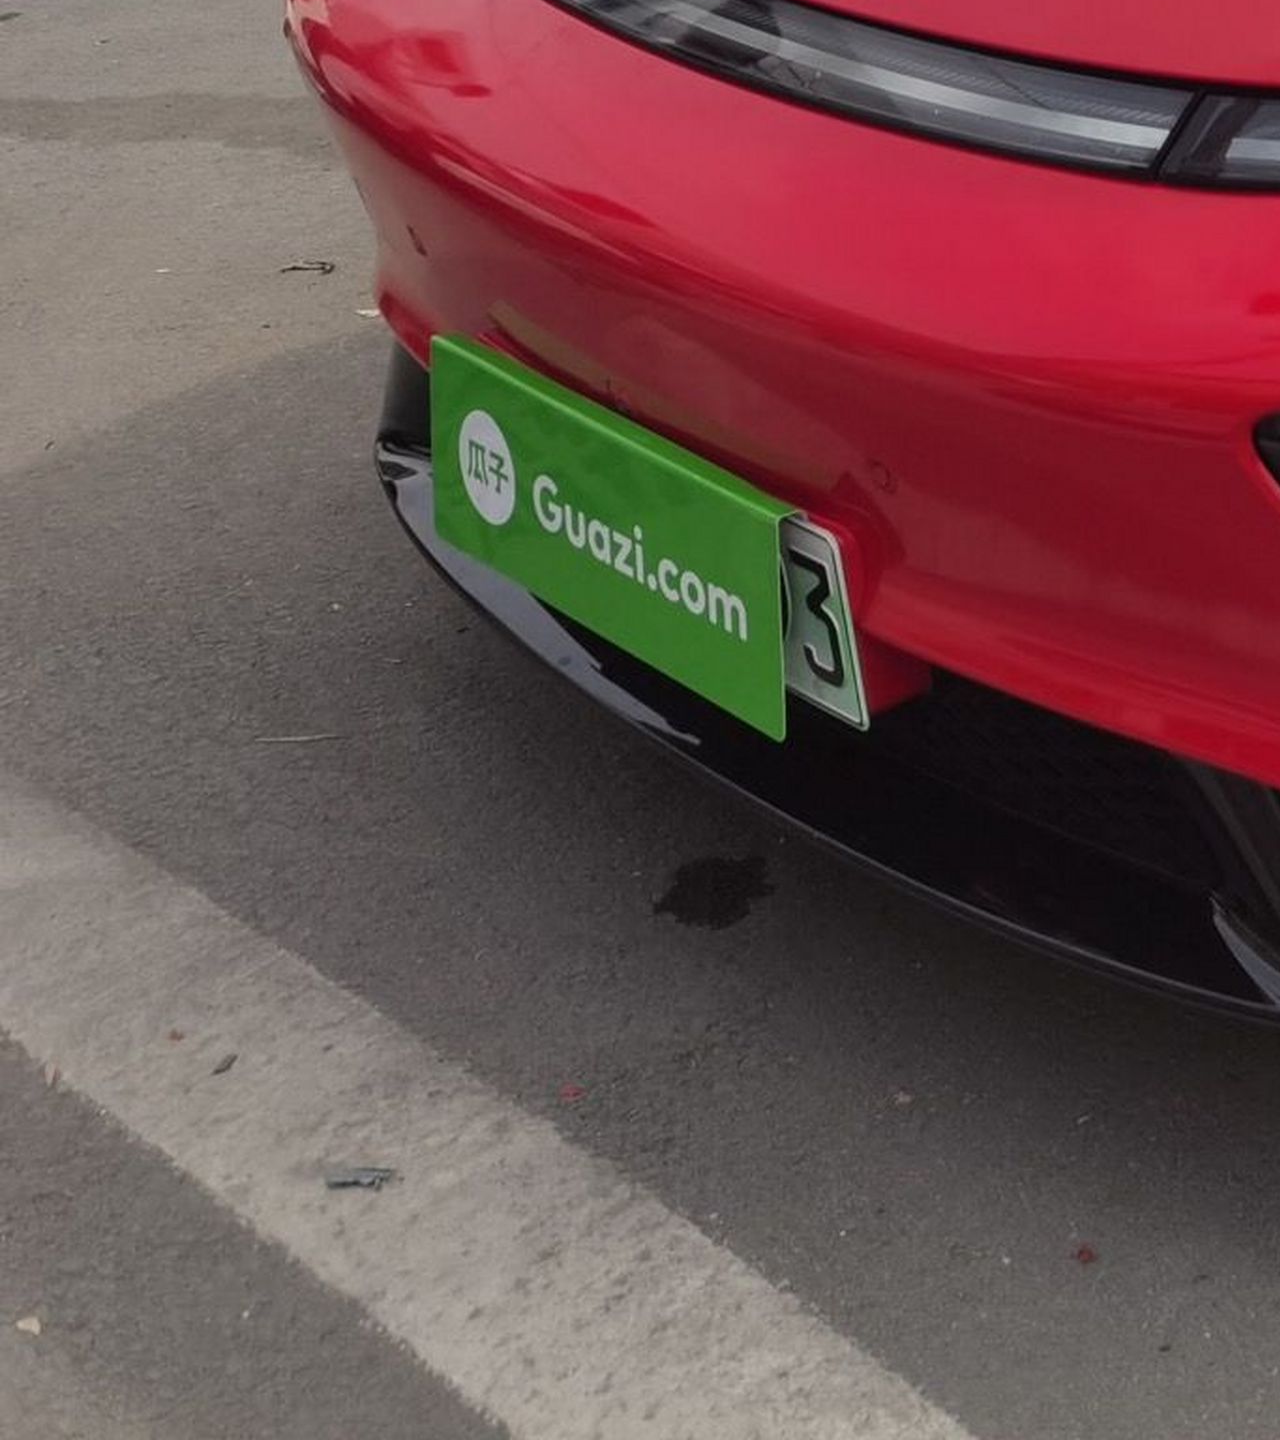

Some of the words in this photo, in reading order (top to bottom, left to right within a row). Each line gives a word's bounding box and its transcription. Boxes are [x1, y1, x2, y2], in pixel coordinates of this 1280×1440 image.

[468, 439, 509, 494] 瓜子
[532, 474, 748, 642] Guazi.com
[780, 546, 844, 688] 3
